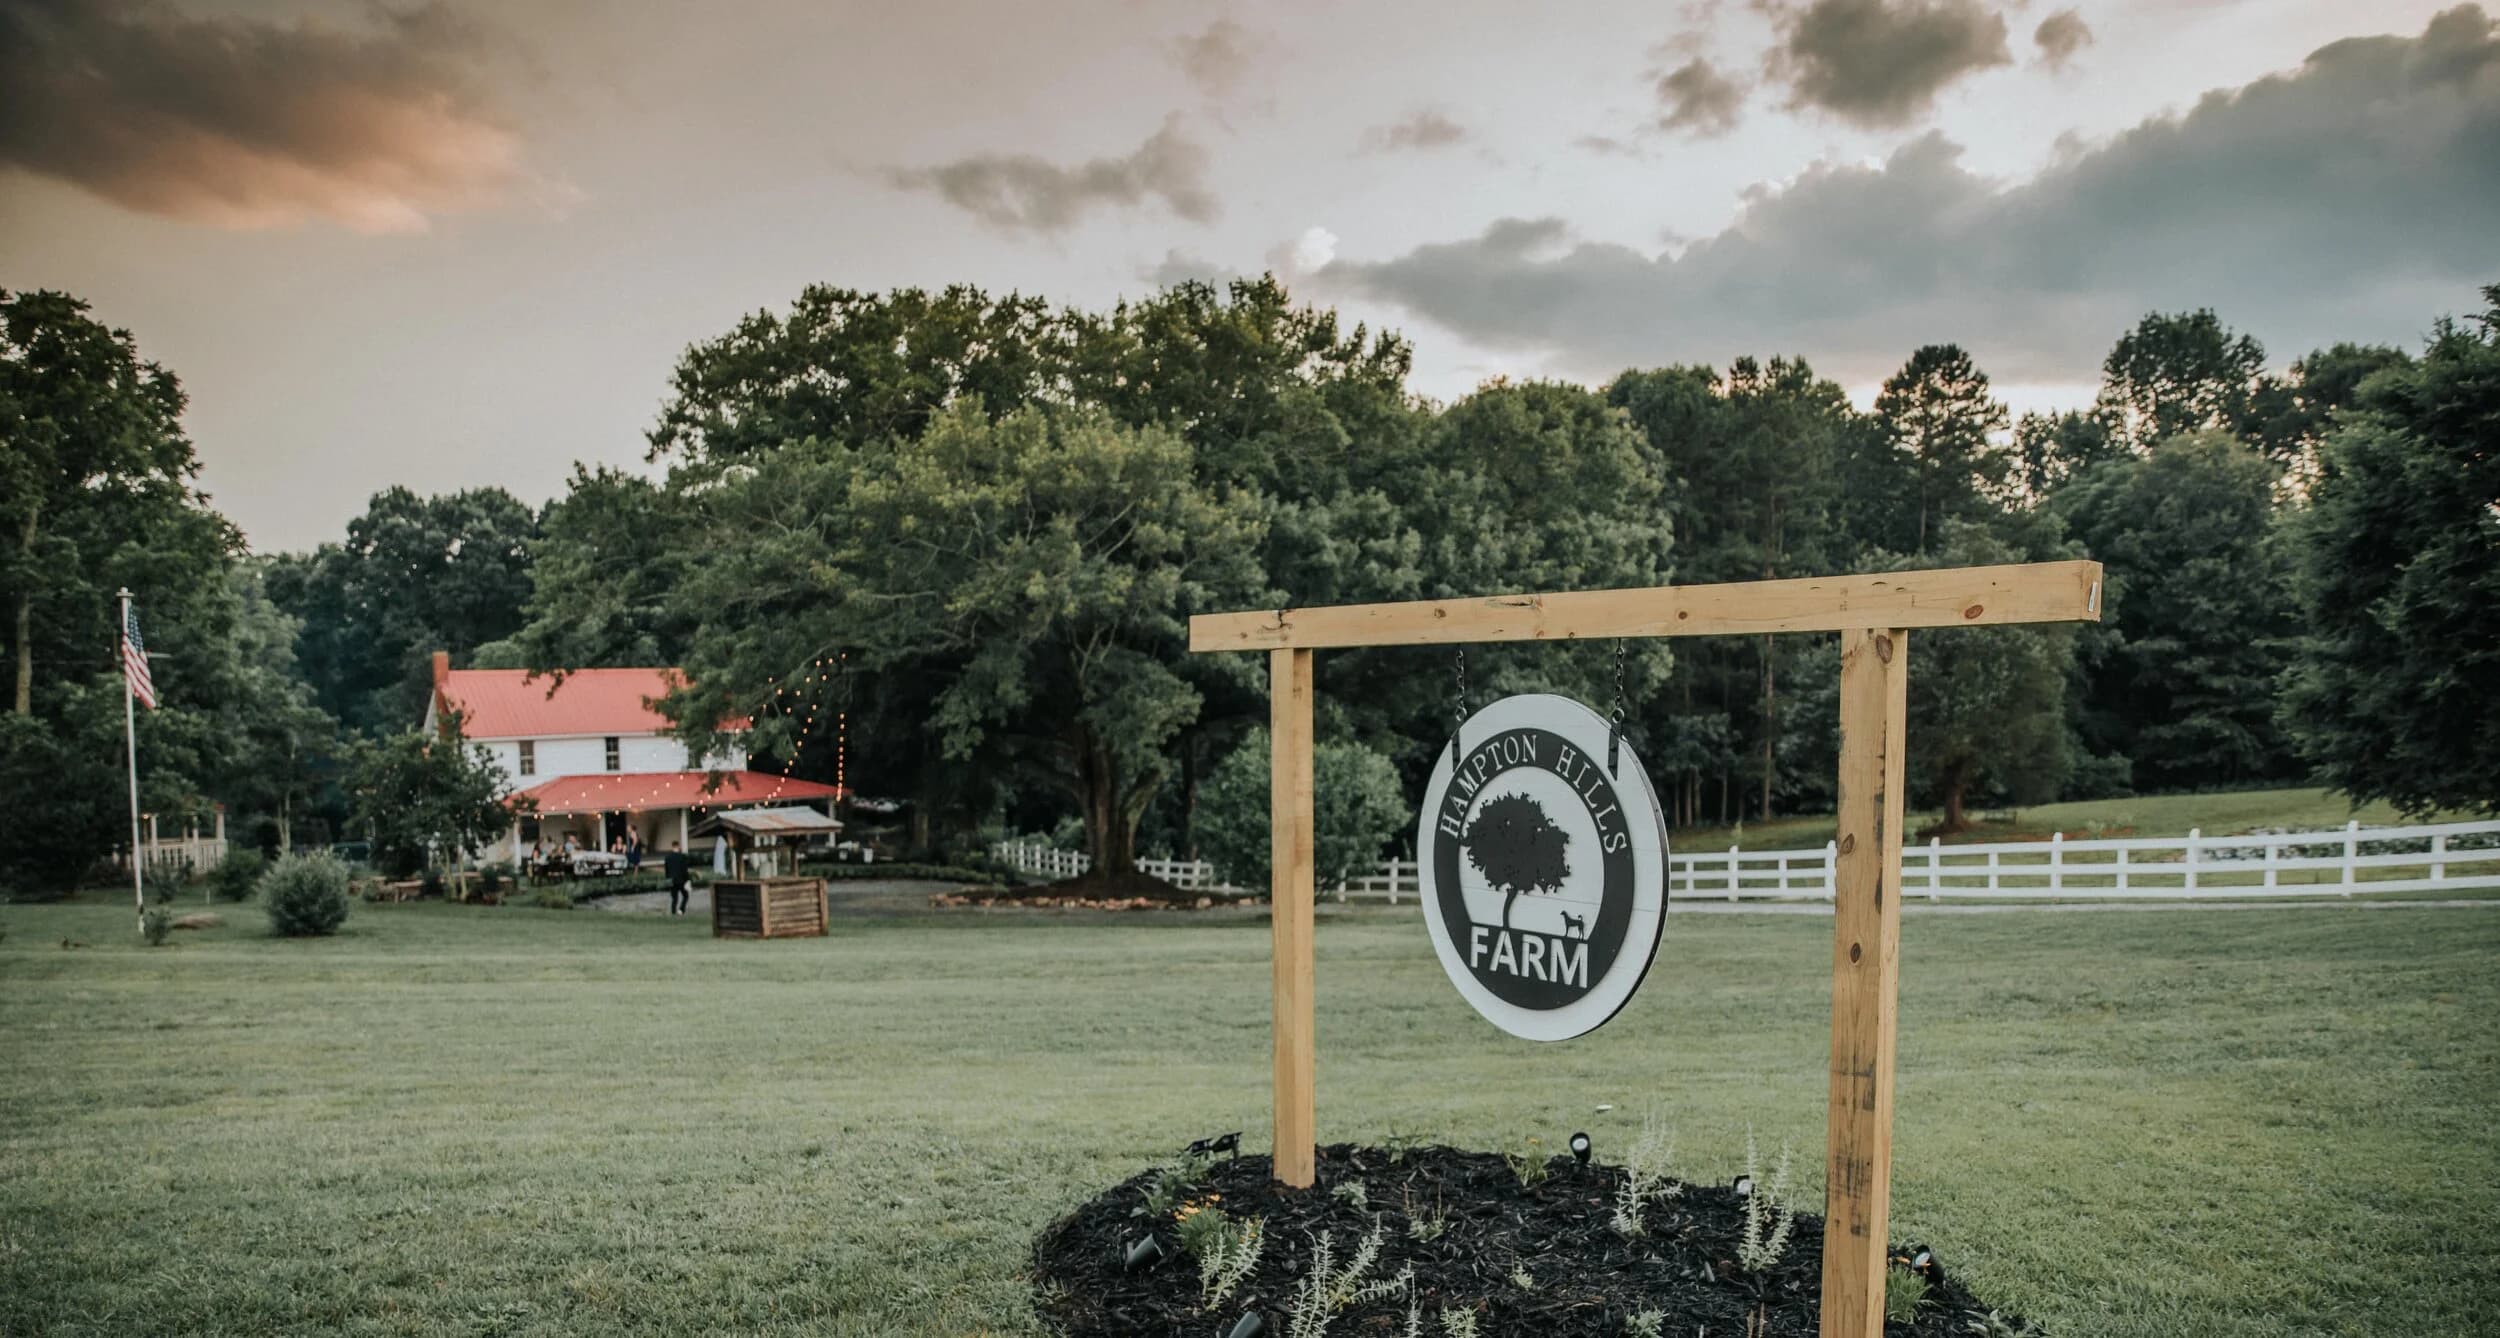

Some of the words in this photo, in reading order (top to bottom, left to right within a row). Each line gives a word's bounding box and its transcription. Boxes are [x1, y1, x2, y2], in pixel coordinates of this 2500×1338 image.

[1440, 734, 1537, 838] HAMPTON
[1555, 744, 1628, 855] HILLS
[1470, 926, 1589, 989] FARM
